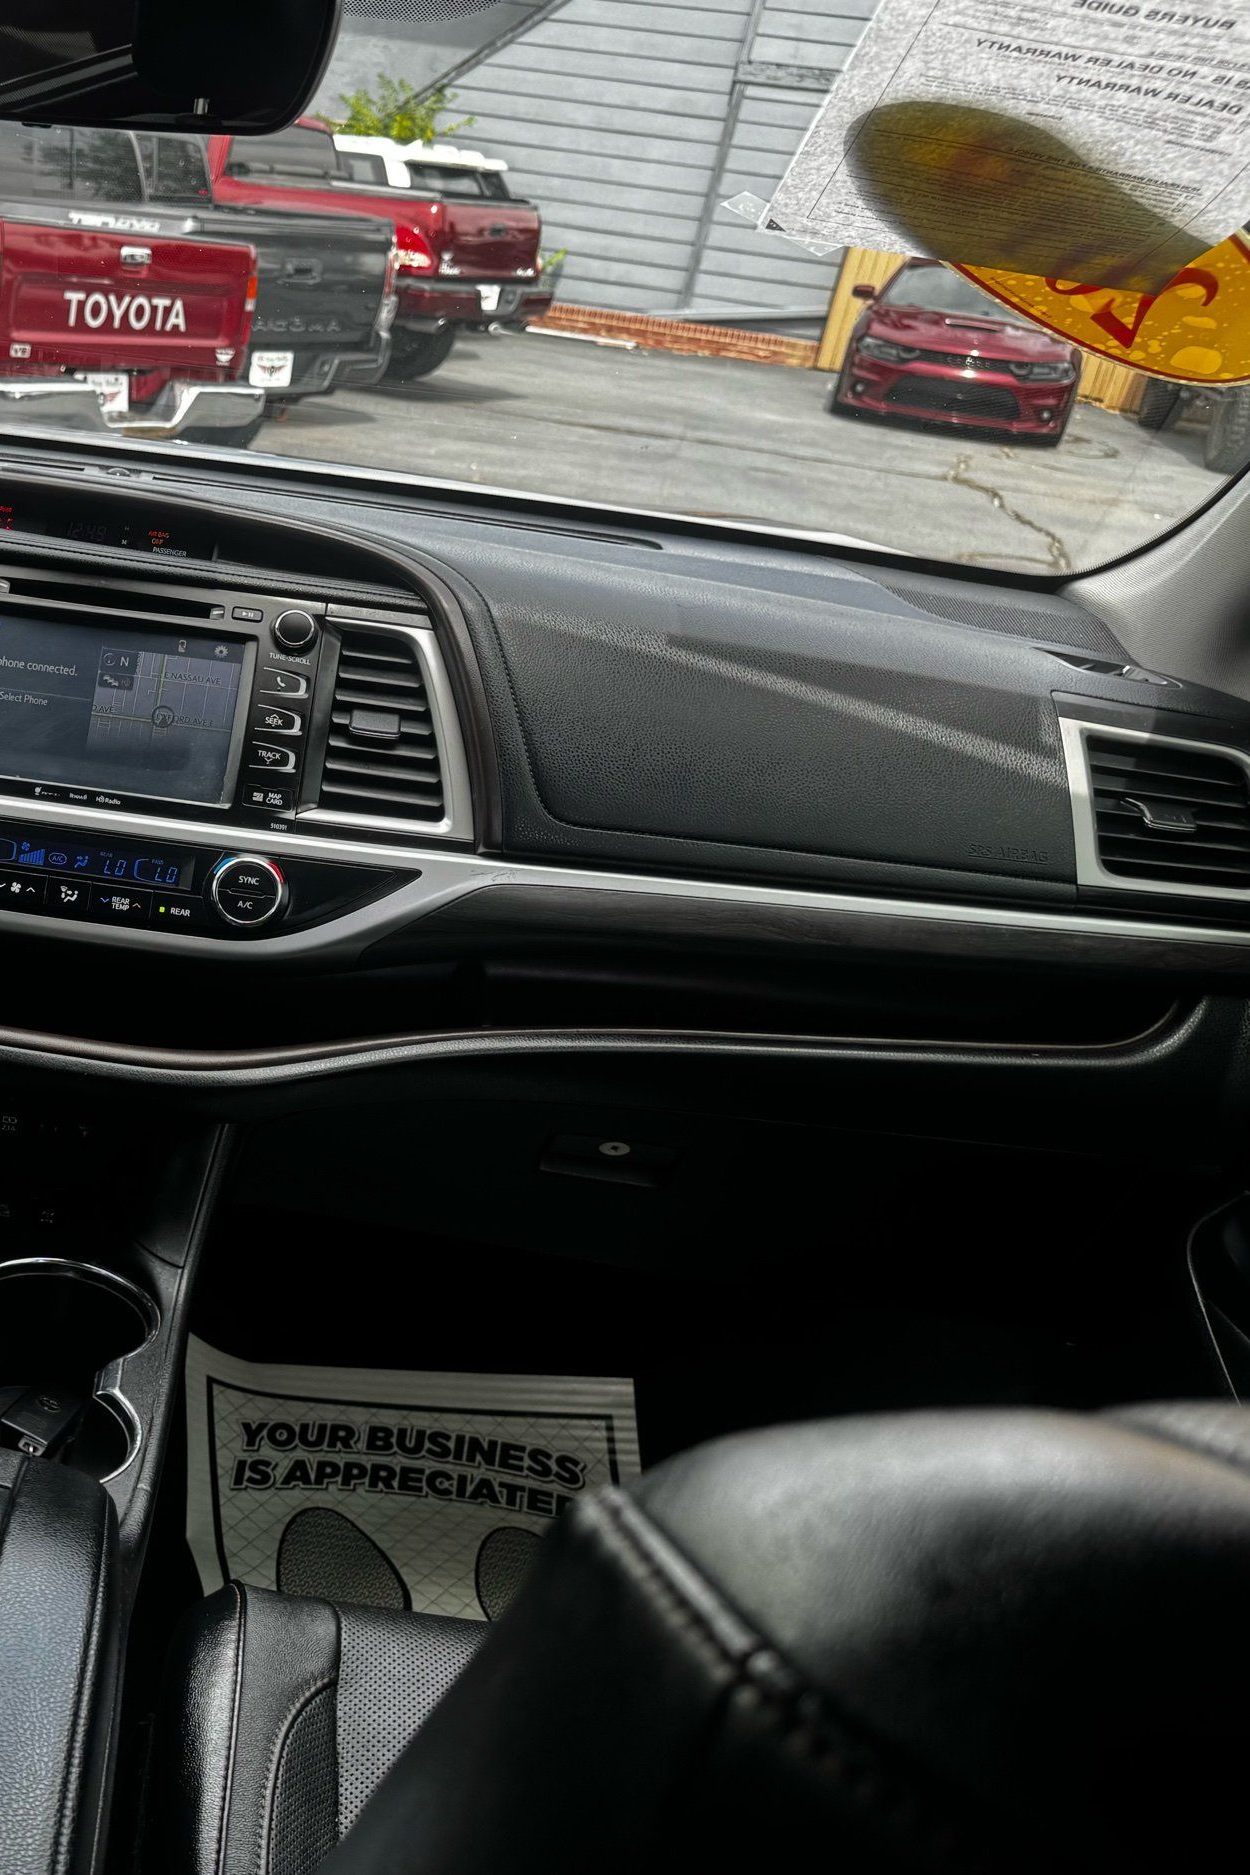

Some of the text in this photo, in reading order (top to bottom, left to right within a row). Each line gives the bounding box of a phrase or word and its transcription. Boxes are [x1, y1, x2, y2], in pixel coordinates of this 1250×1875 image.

[63, 290, 187, 333] TOYOTA
[152, 546, 188, 558] PASSENGER
[119, 656, 130, 667] N
[26, 660, 78, 677] connected.
[170, 673, 204, 685] NASSAU
[205, 677, 222, 686] AVE
[23, 694, 48, 706] Phone
[192, 717, 208, 727] AVE
[265, 716, 283, 727] SEEK
[258, 750, 281, 760] TRACK
[104, 797, 121, 805] Radio
[266, 797, 283, 806] CARD
[268, 792, 283, 801] MAP
[238, 875, 260, 886] SYNC
[111, 895, 130, 905] REAR
[237, 900, 253, 910] A/C
[111, 902, 130, 911] TEMP
[170, 907, 191, 917] REAR
[239, 1418, 587, 1491] YOUR BUSINESS
[229, 1455, 279, 1490] IS
